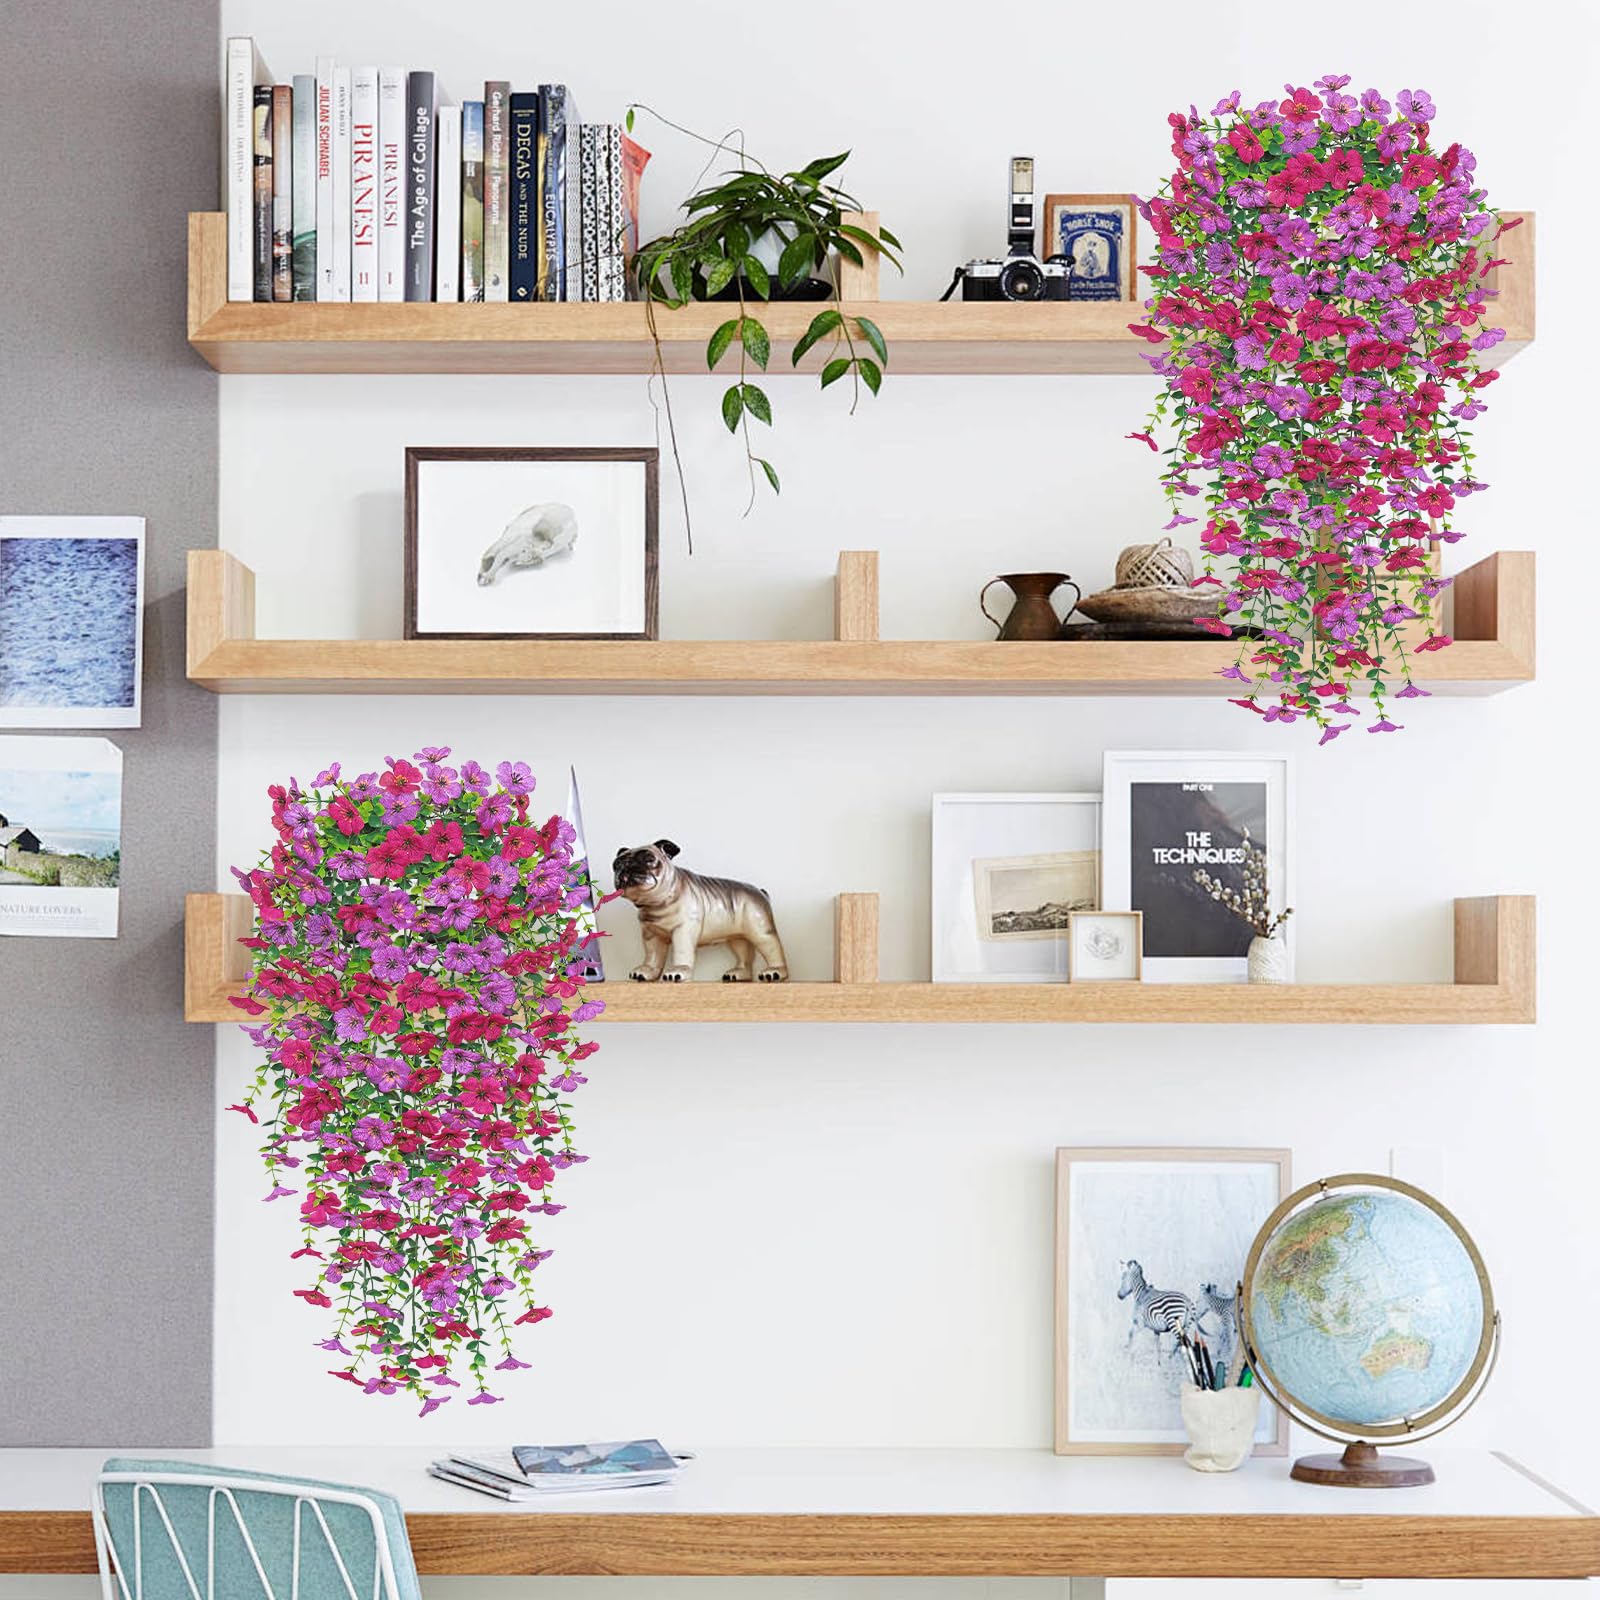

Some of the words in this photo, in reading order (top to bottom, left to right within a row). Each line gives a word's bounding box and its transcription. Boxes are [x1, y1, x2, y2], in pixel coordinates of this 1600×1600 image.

[319, 85, 330, 123] JULIAN
[491, 91, 503, 132] Gerhard
[411, 106, 430, 164] Collage
[491, 134, 502, 168] Richter
[517, 123, 532, 180] DEGAS
[319, 125, 330, 180] SCHNABEL
[353, 124, 373, 246] PIRANESI
[384, 143, 398, 227] PIRANESI
[413, 167, 426, 182] of
[519, 183, 527, 200] AND
[412, 186, 429, 217] Age
[491, 176, 502, 225] Panorama
[518, 203, 528, 224] THE
[411, 221, 425, 249] The
[518, 225, 528, 260] NUDE
[545, 194, 556, 262] EUCALYPTS
[1182, 784, 1198, 792] PART
[1199, 784, 1213, 792] ONE
[1152, 848, 1246, 864] TECHNIQUES
[1185, 832, 1212, 848] THE
[43, 904, 83, 915] LOVERS
